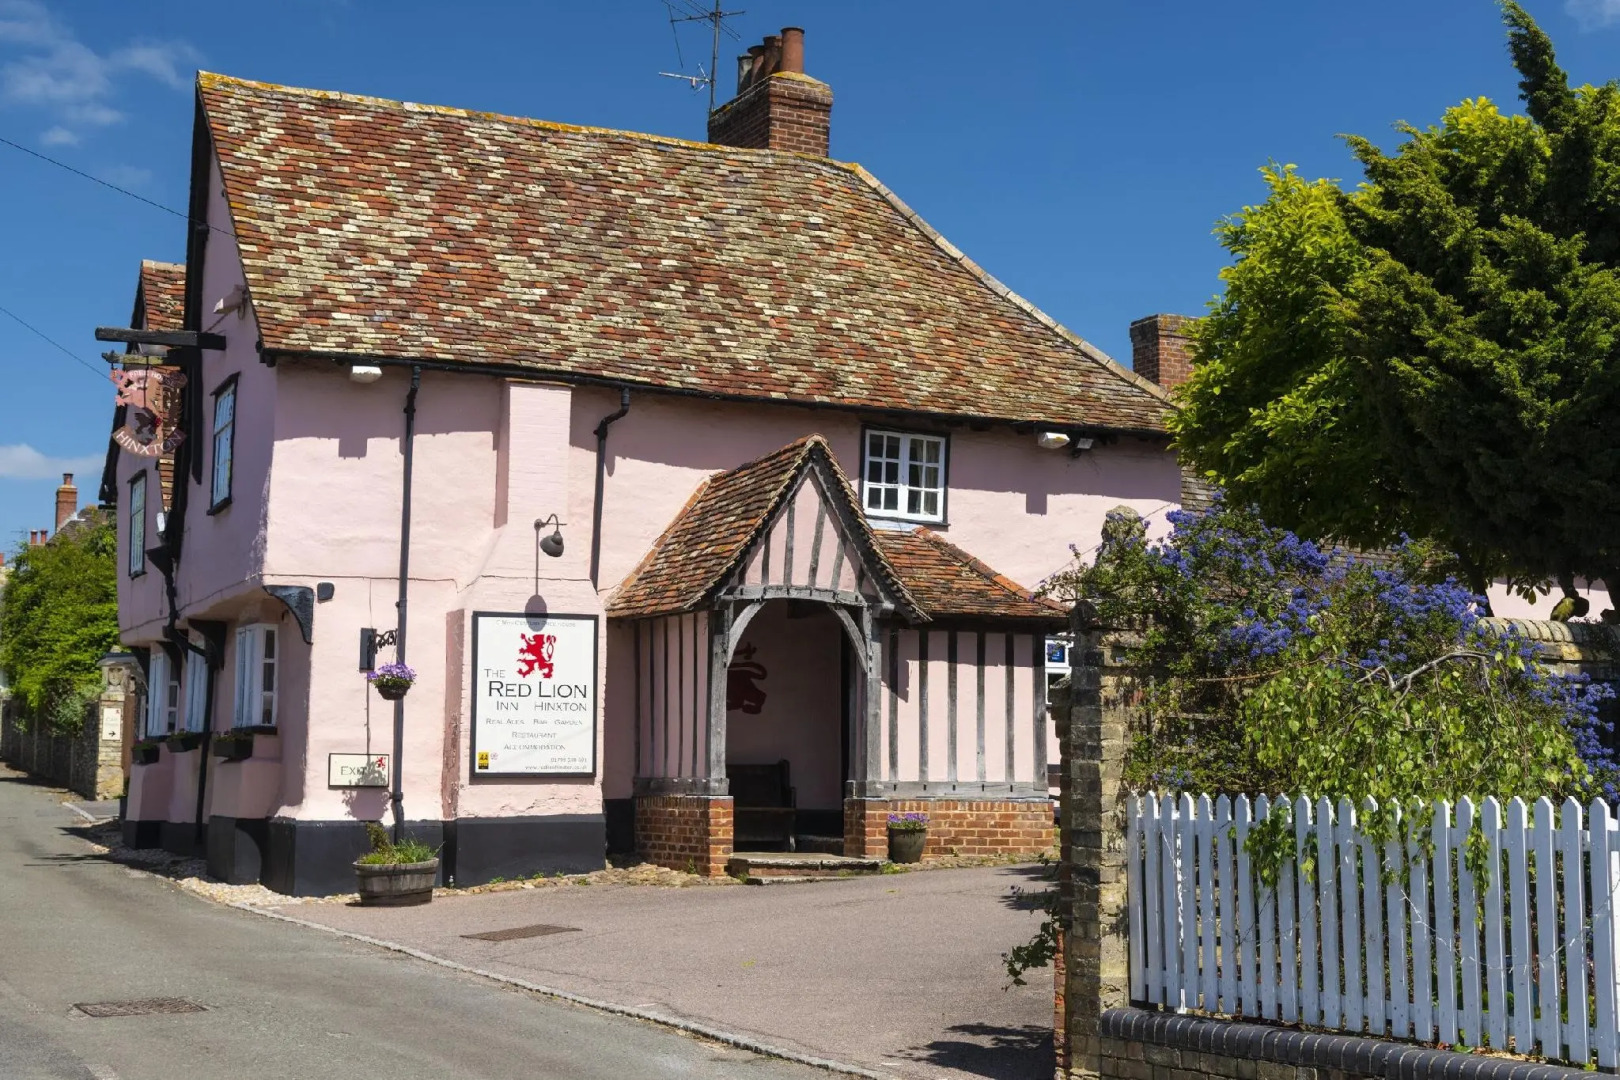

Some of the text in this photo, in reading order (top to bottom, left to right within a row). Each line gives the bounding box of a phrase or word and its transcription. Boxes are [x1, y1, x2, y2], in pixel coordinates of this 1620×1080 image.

[484, 668, 506, 678] THE
[488, 680, 587, 698] RED LION
[496, 700, 587, 712] INN HINXTON
[341, 766, 367, 775] EXIT
